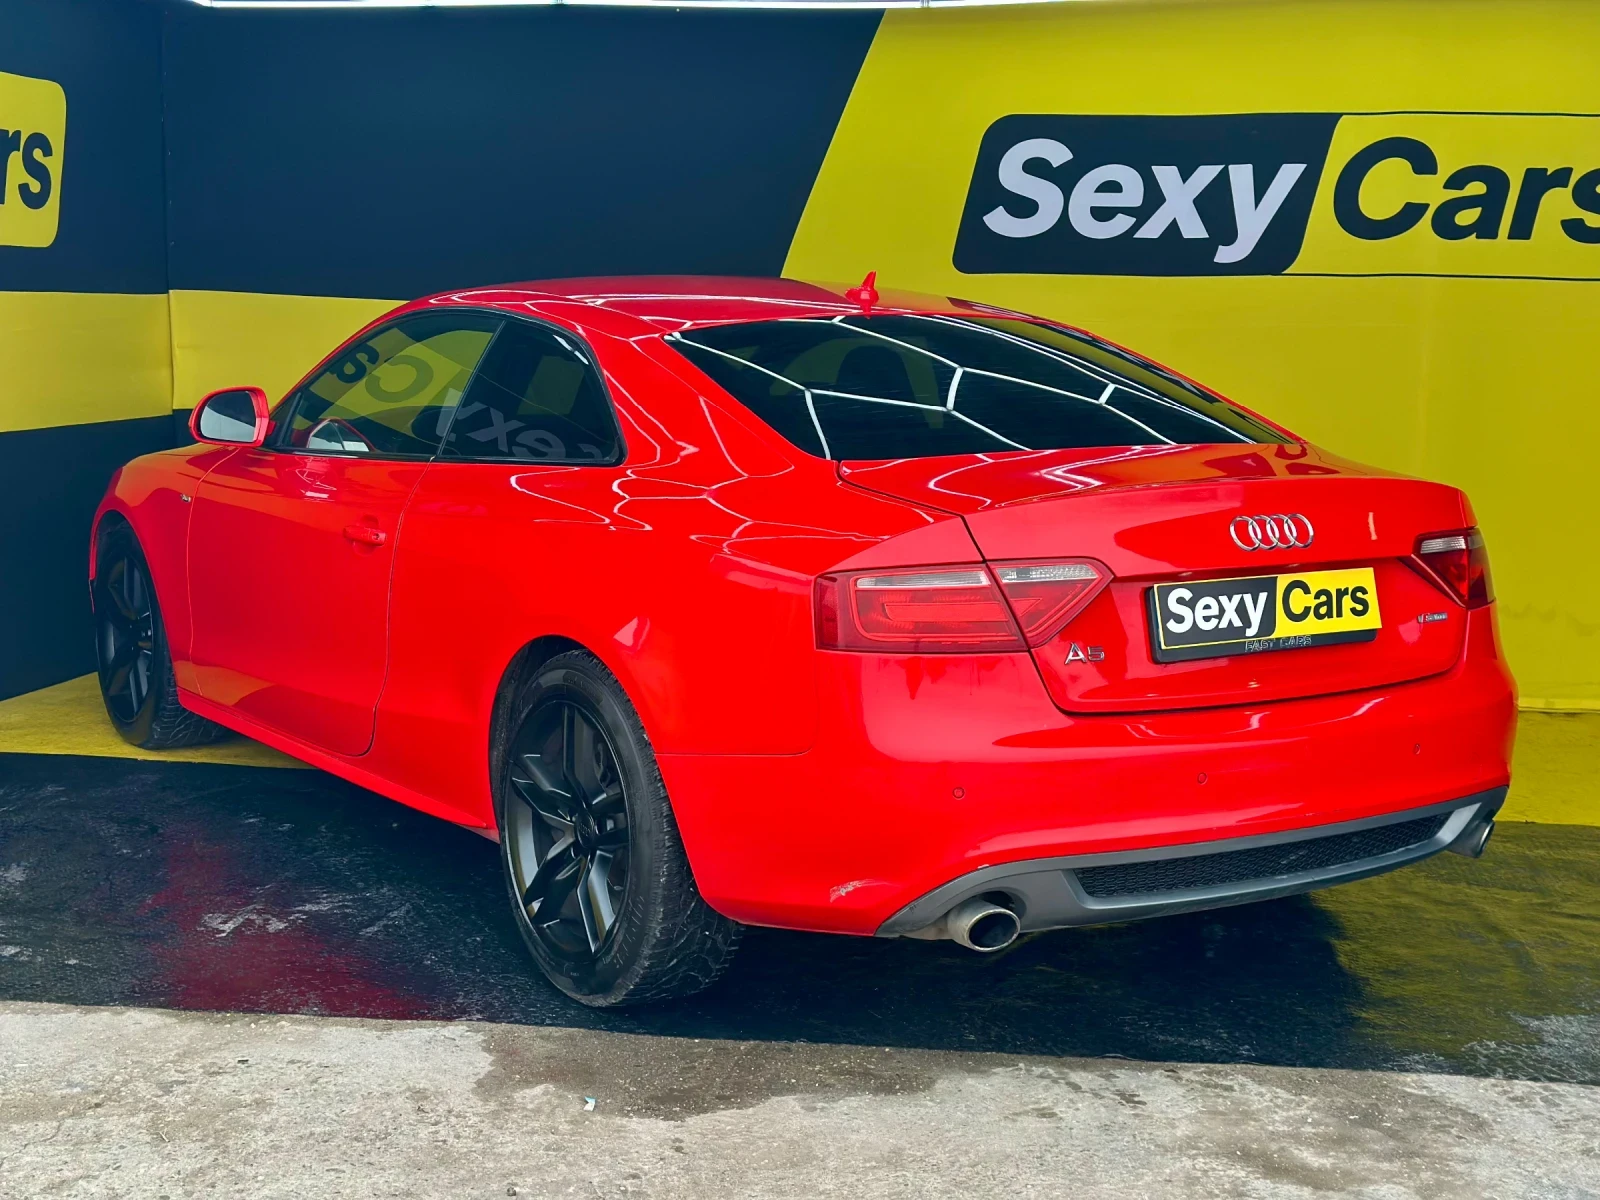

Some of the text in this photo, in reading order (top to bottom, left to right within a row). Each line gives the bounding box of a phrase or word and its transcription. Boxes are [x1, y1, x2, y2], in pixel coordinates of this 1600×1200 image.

[982, 136, 1600, 263] Sexy Cars
[1165, 579, 1370, 637] Sexy Cars
[1064, 641, 1105, 665] A5
